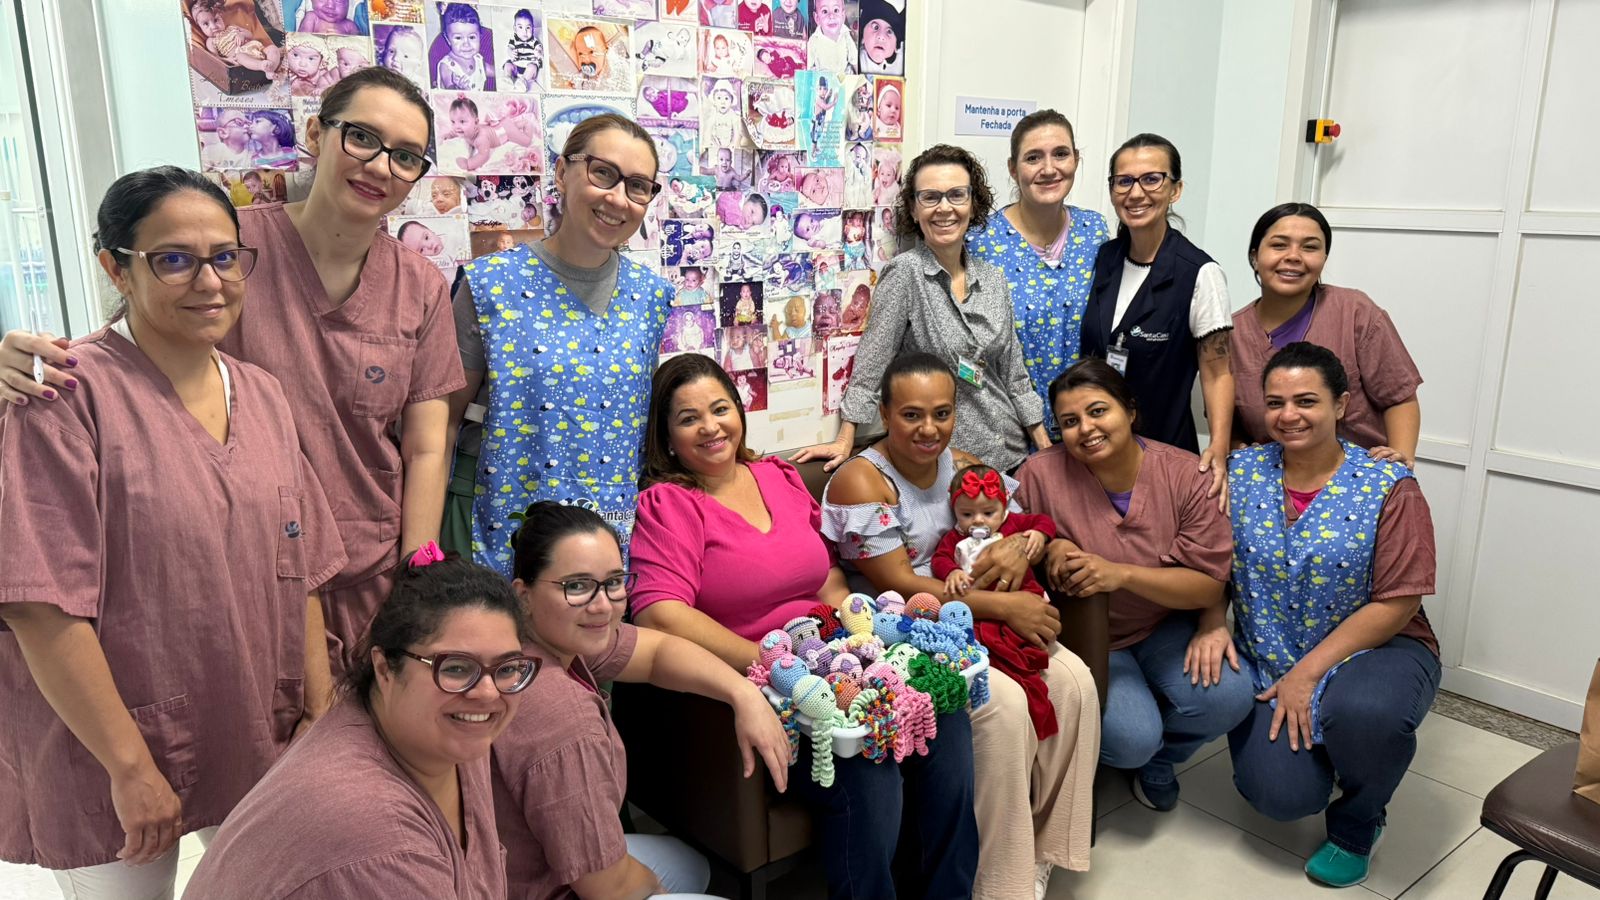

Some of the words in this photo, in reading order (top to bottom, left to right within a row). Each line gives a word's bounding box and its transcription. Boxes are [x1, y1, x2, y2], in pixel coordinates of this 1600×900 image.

[964, 104, 1000, 116] Mantenha
[1001, 108, 1006, 116] a
[1006, 107, 1027, 118] porta
[980, 119, 1012, 130] Fechada
